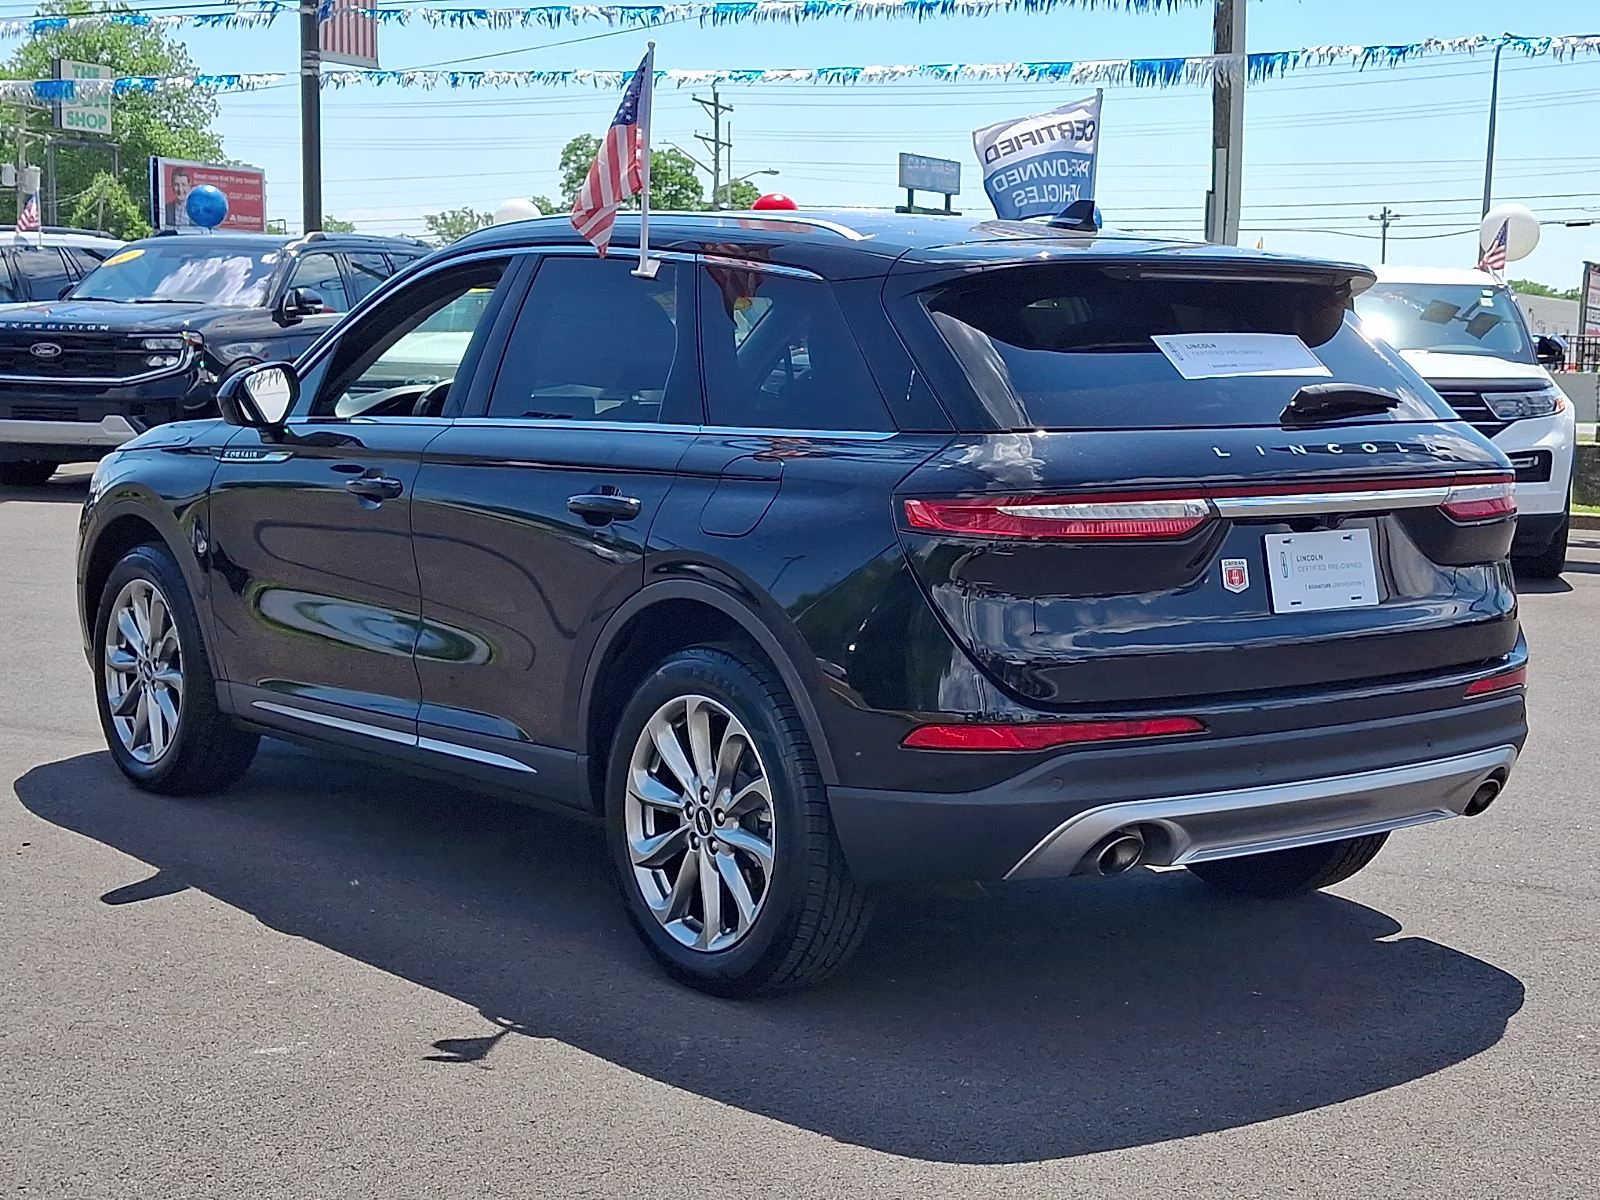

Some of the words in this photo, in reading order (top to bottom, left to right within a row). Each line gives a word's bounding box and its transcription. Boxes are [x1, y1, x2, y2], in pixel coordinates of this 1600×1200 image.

[72, 64, 99, 78] THE
[66, 111, 107, 129] SHOP
[1213, 442, 1438, 457] LINCOLN
[1296, 554, 1323, 562] LINCOLN
[1297, 563, 1327, 573] CERTIFIED
[1327, 561, 1363, 571] PRE-OWNED
